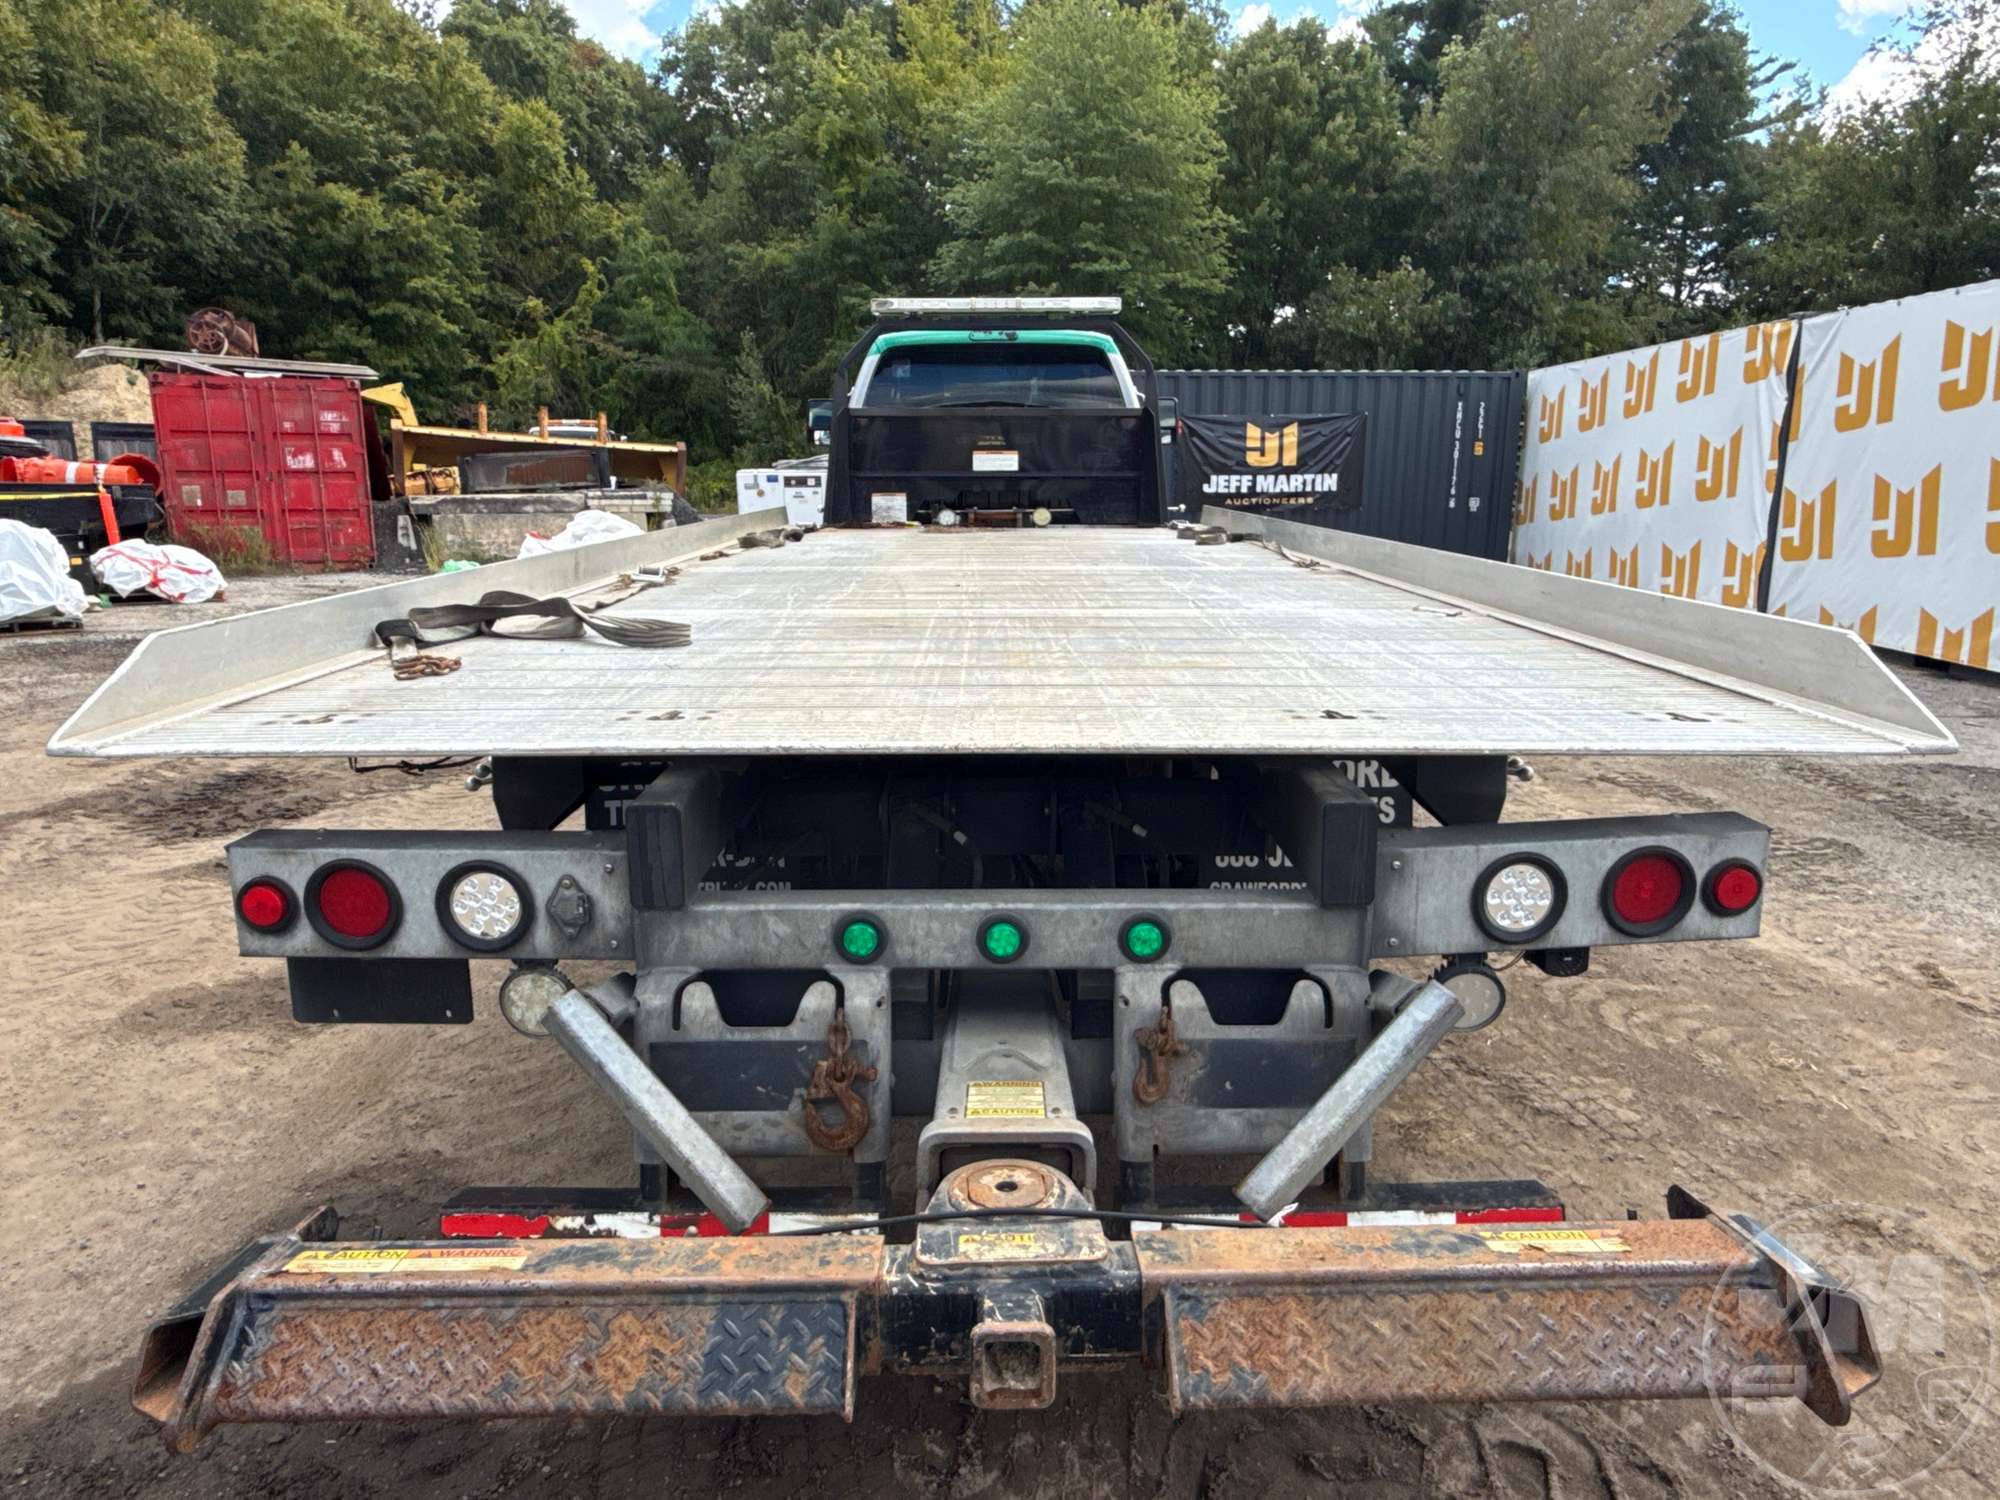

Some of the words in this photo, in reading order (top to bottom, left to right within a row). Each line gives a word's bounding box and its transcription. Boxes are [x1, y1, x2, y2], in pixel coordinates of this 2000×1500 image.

[1202, 474, 1253, 493] JEFF
[1255, 473, 1338, 492] MARTIN
[1225, 496, 1314, 505] AUCTIONEERS
[1209, 881, 1308, 890] CRAWFORD
[1505, 1231, 1585, 1240] CAUTION
[440, 1249, 522, 1258] WARNING
